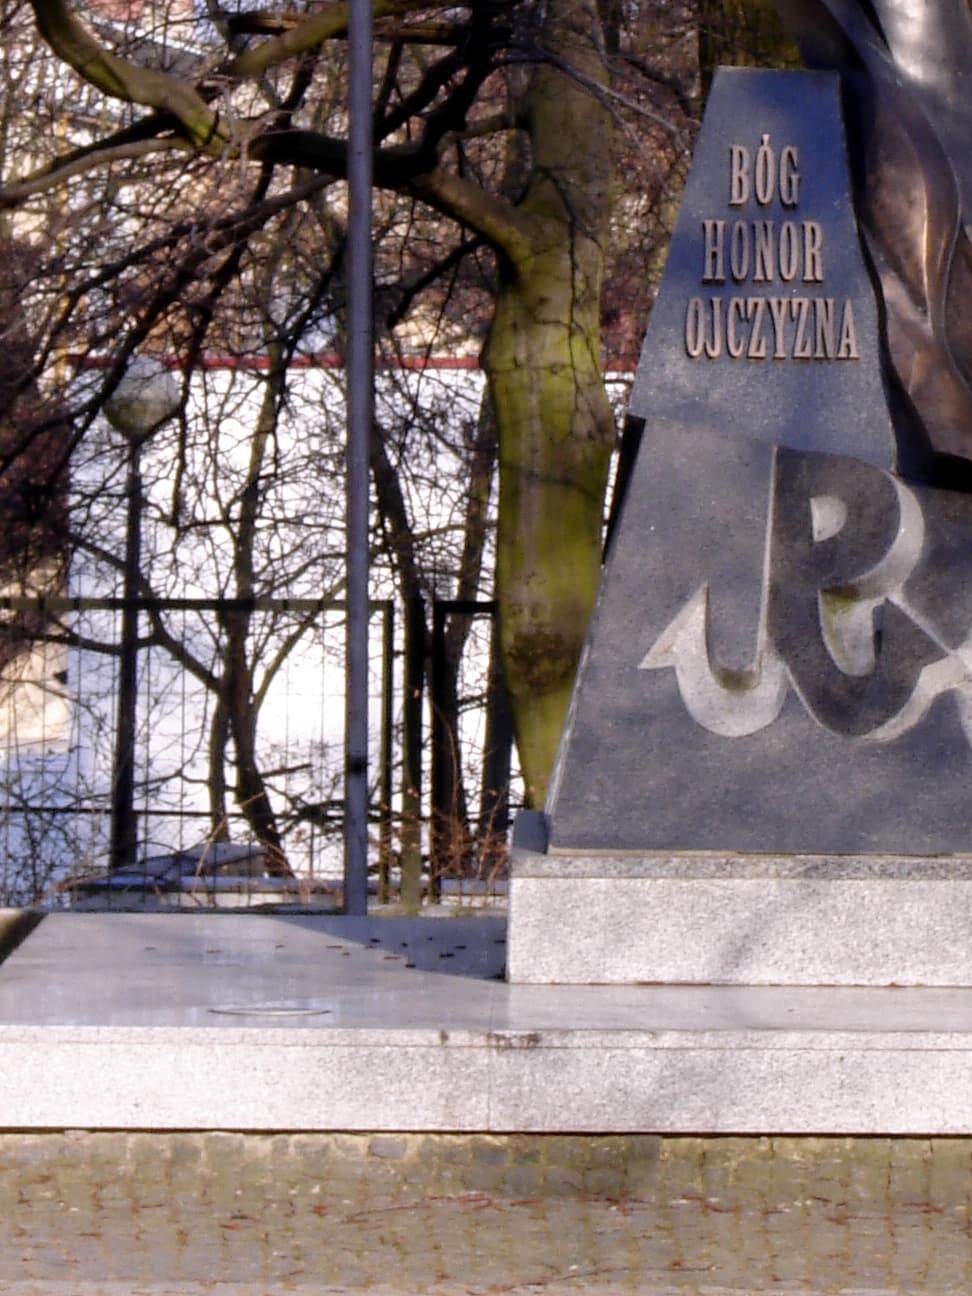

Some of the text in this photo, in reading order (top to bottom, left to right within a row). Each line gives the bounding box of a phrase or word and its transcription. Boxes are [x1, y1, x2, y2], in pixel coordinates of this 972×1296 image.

[729, 134, 800, 206] BÓG
[702, 220, 824, 283] HONOR
[686, 296, 860, 360] OJCZYZNA
